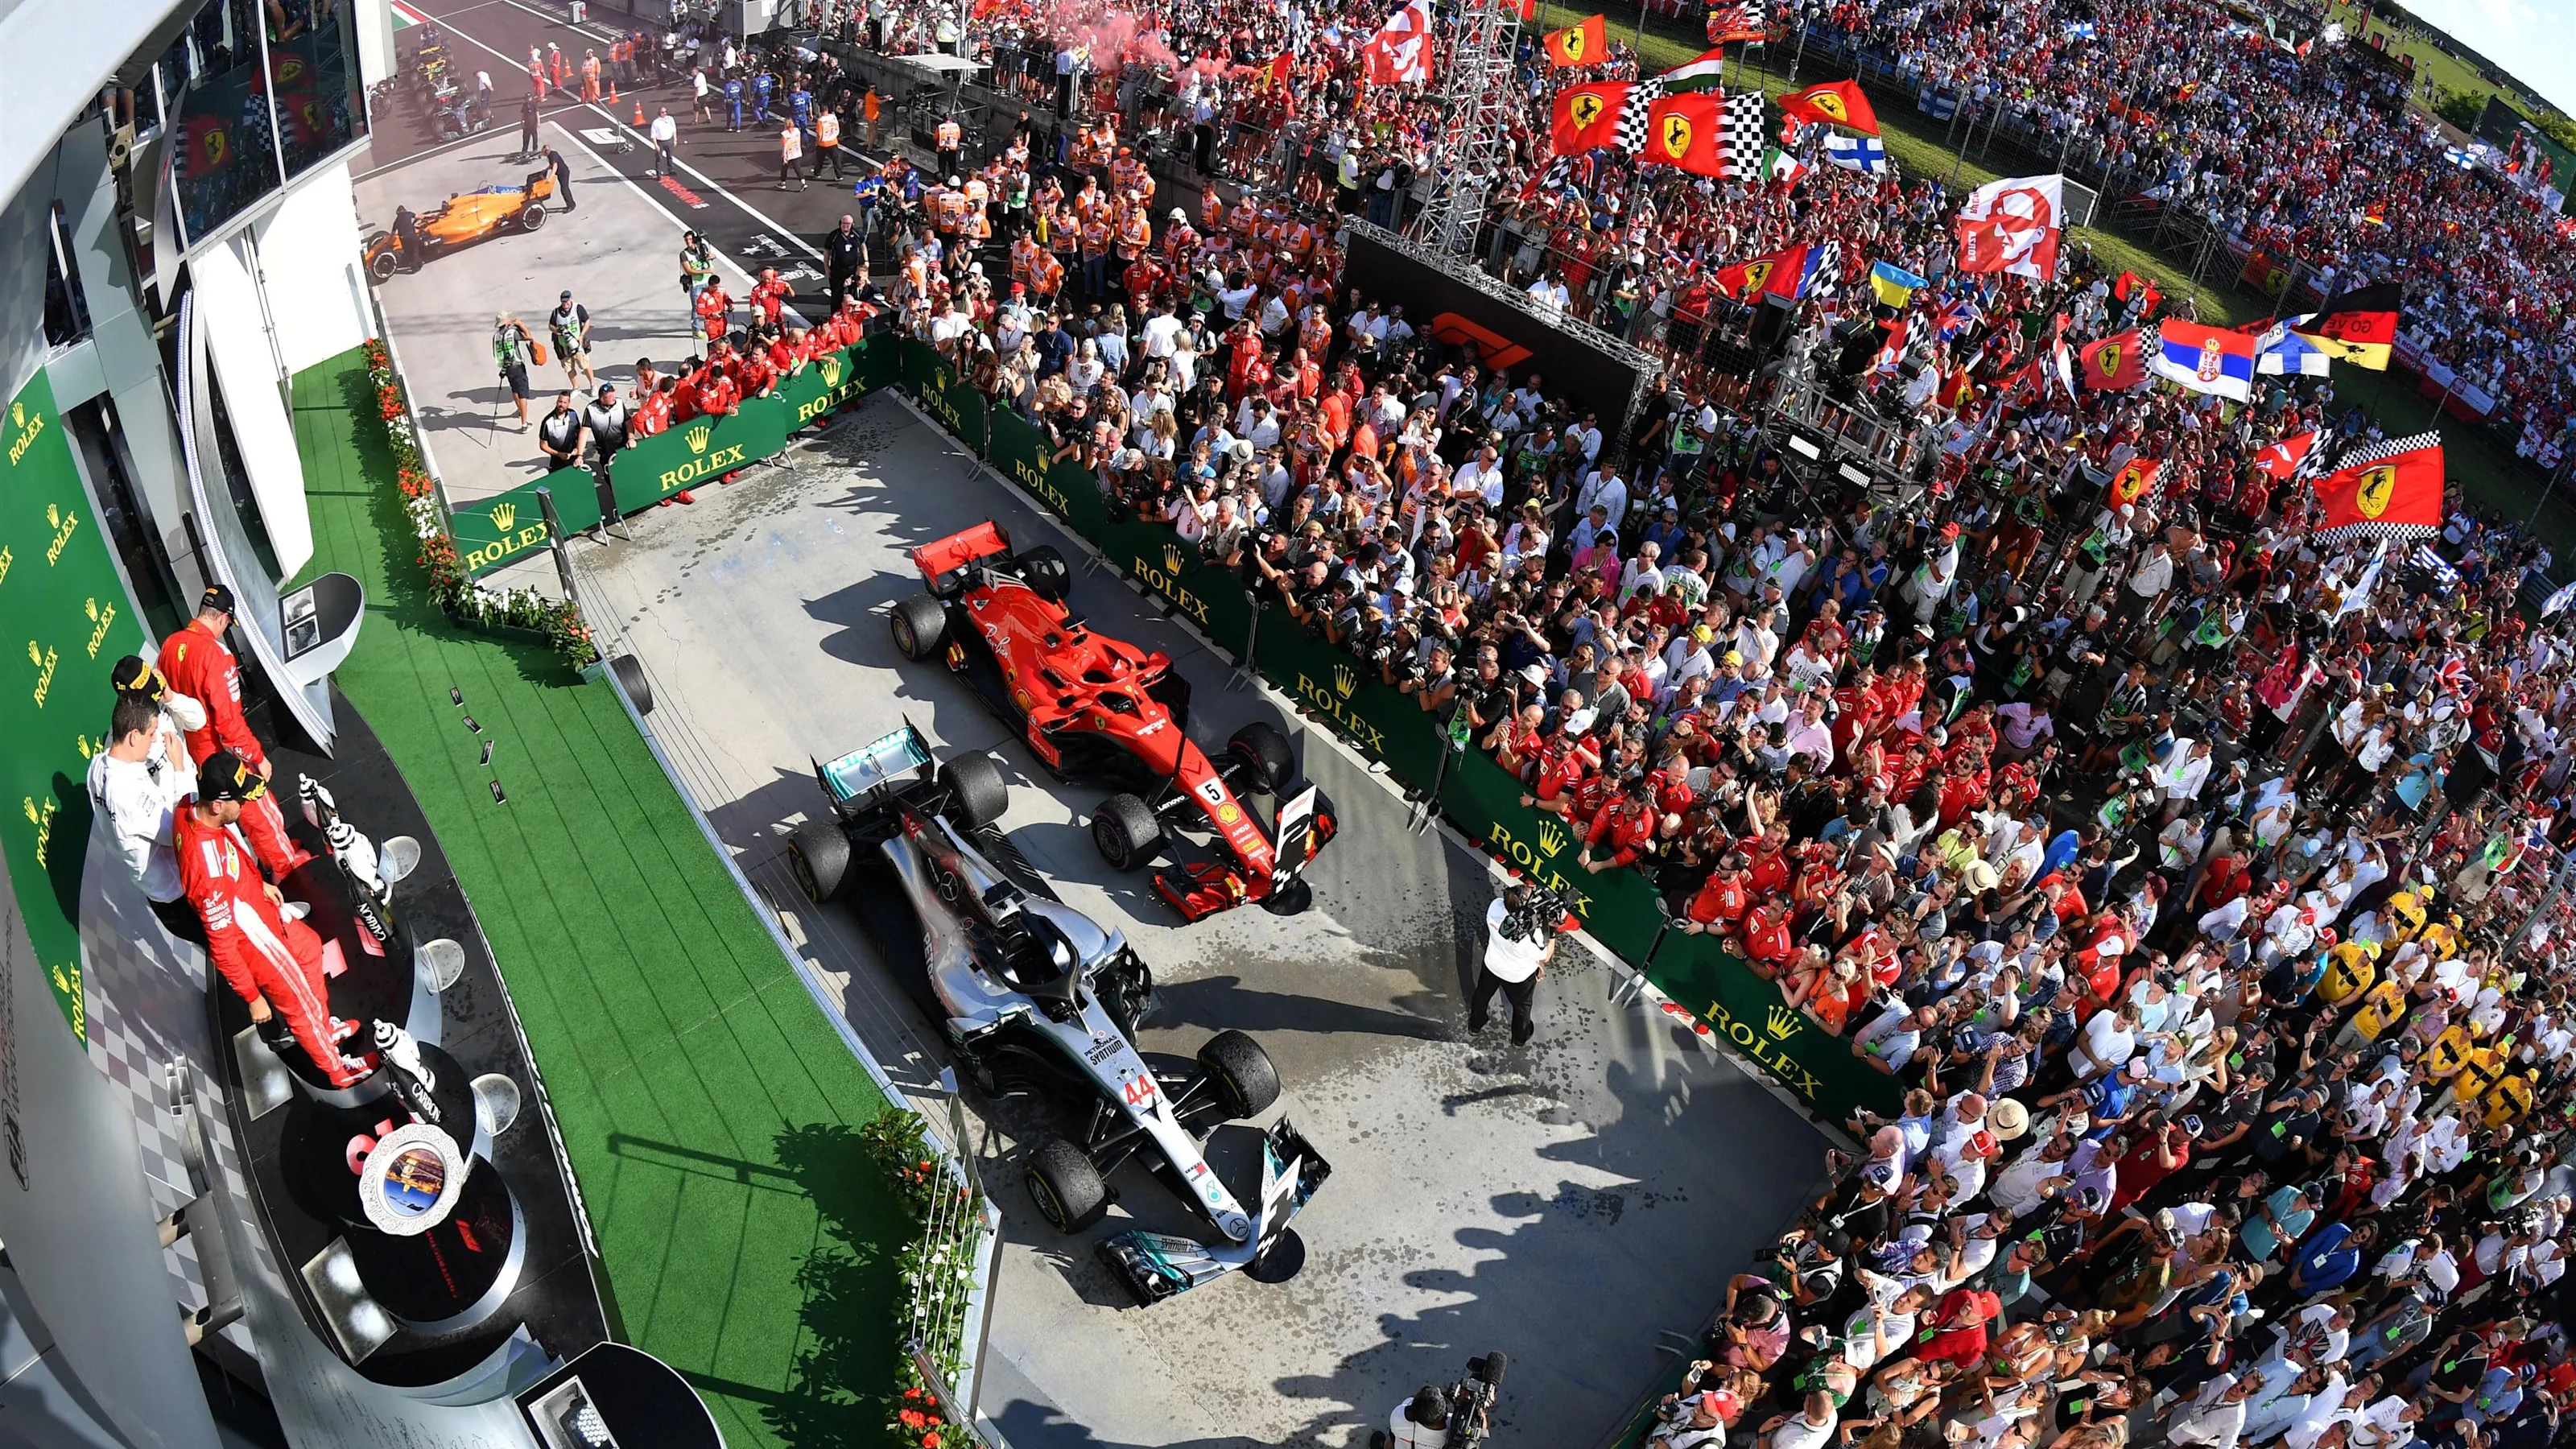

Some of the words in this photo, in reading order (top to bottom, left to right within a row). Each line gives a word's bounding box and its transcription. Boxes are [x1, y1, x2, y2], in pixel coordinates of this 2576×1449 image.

[799, 376, 868, 423] ROLEX
[921, 381, 963, 431] ROLEX
[8, 412, 45, 466] ROLEX
[659, 444, 745, 492] ROLEX
[1014, 458, 1070, 517] ROLEX
[46, 510, 79, 568] ROLEX
[465, 522, 547, 572] ROLEX
[1134, 555, 1209, 625] ROLEX
[86, 601, 117, 660] ROLEX
[34, 645, 58, 708] ROLEX
[1296, 671, 1385, 755] ROLEX
[1204, 782, 1221, 802] 5
[1220, 763, 1241, 778] Lenovo
[1157, 795, 1186, 811] Lenovo
[36, 795, 56, 870] ROLEX
[1488, 821, 1593, 919] ROLEX
[357, 902, 386, 942] CARBON
[69, 960, 85, 1043] ROLEX
[1084, 1034, 1117, 1057] PETRONAS
[1090, 1039, 1125, 1066] SYNTIUM
[1703, 1000, 1823, 1101] ROLEX
[411, 1082, 442, 1123] CARBON
[1125, 1074, 1156, 1105] 44
